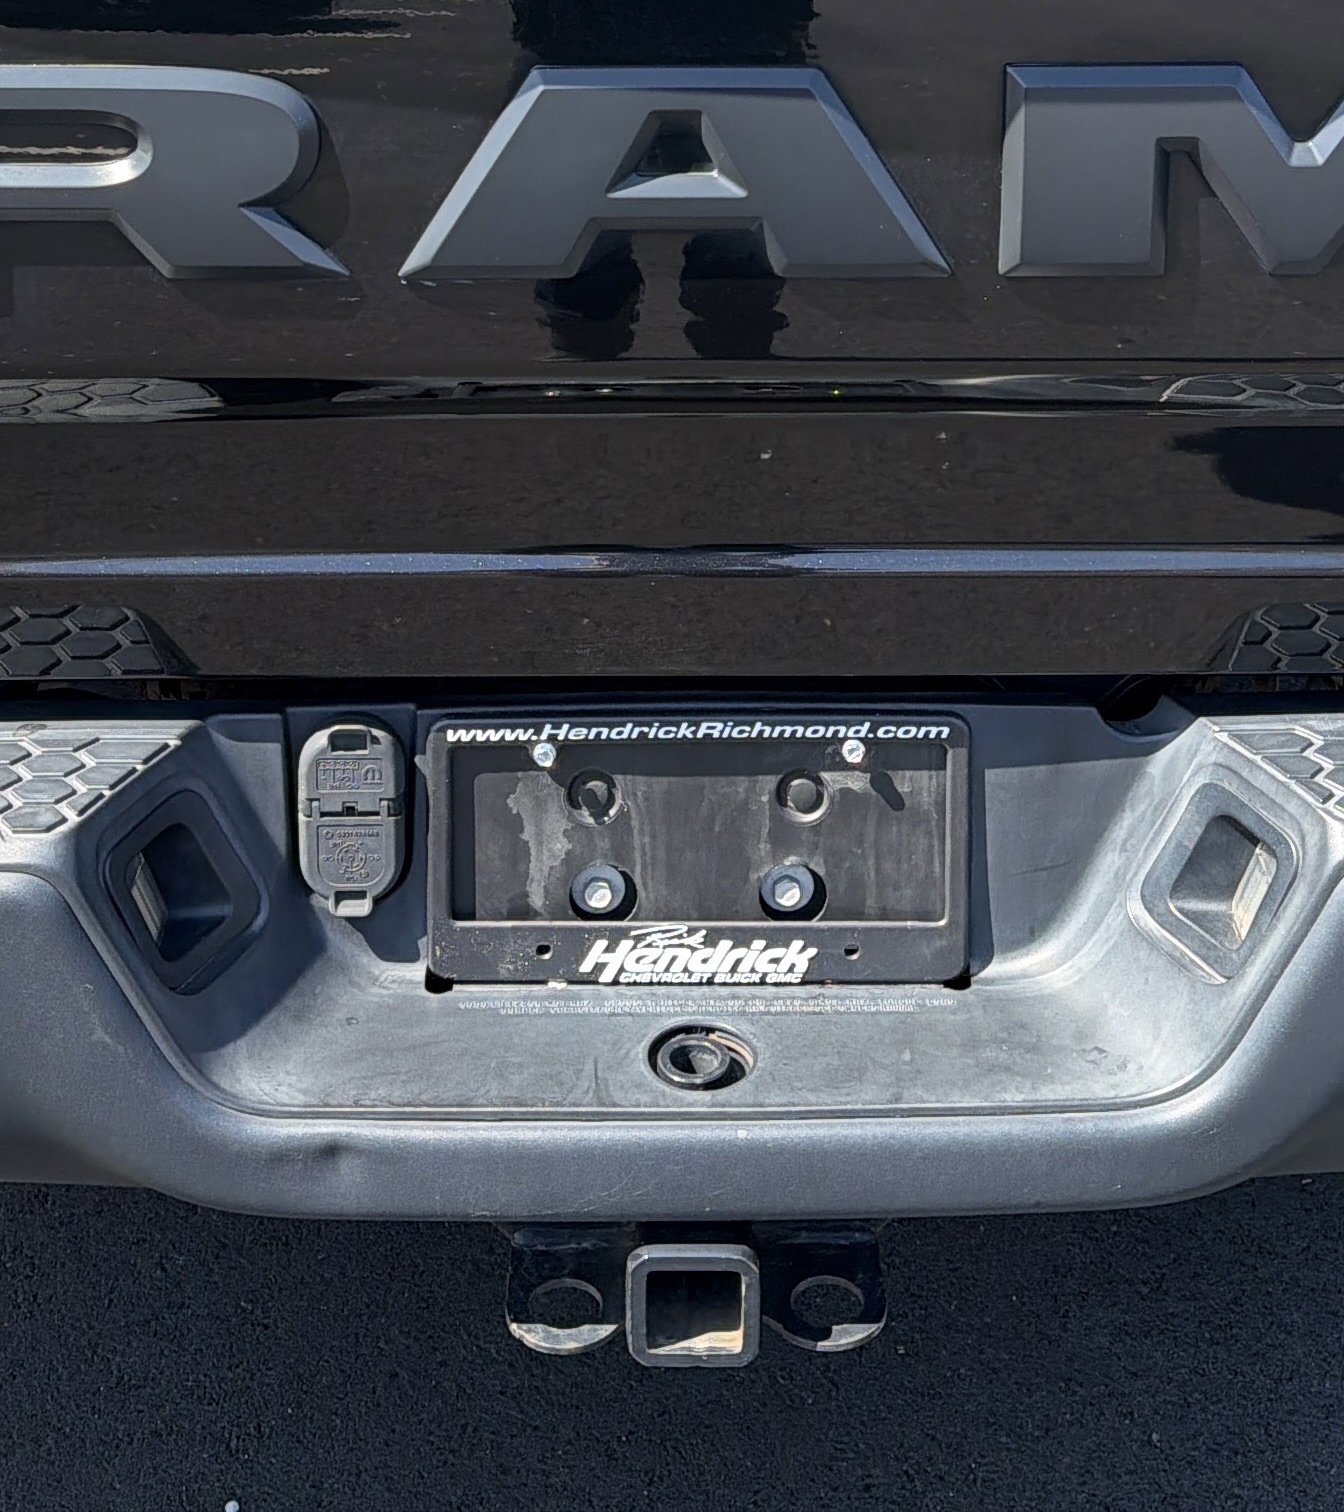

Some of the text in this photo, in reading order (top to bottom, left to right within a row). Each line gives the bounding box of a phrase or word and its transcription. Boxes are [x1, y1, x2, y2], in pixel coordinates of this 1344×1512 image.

[446, 722, 951, 742] www.HendrickRichmond.com
[629, 924, 708, 950] Rick
[578, 939, 819, 984] Hendrick
[618, 972, 805, 984] CHEVROLET BUICK GMC
